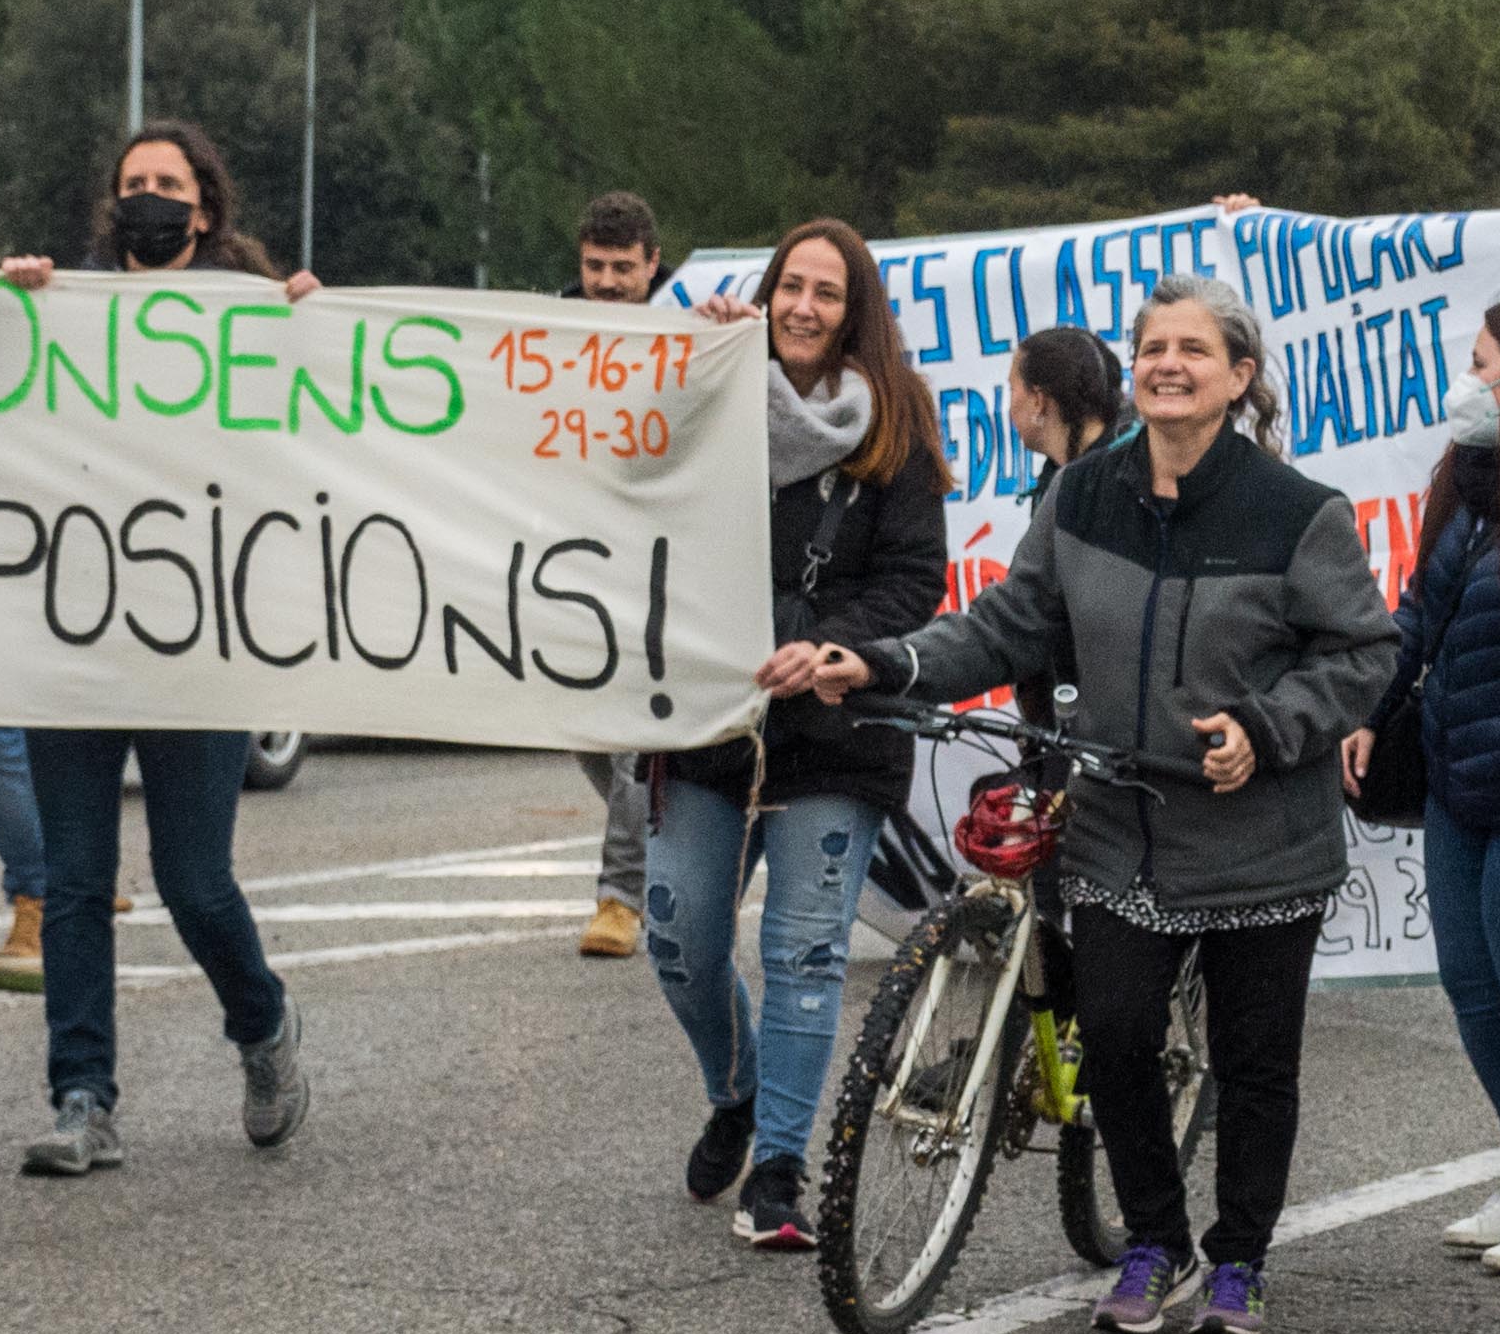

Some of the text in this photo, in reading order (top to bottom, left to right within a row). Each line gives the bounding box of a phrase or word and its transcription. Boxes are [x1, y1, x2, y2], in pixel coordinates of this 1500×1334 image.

[489, 327, 694, 395] 15-16-17
[1284, 295, 1450, 458] UALITAT
[532, 407, 670, 460] 29-30
